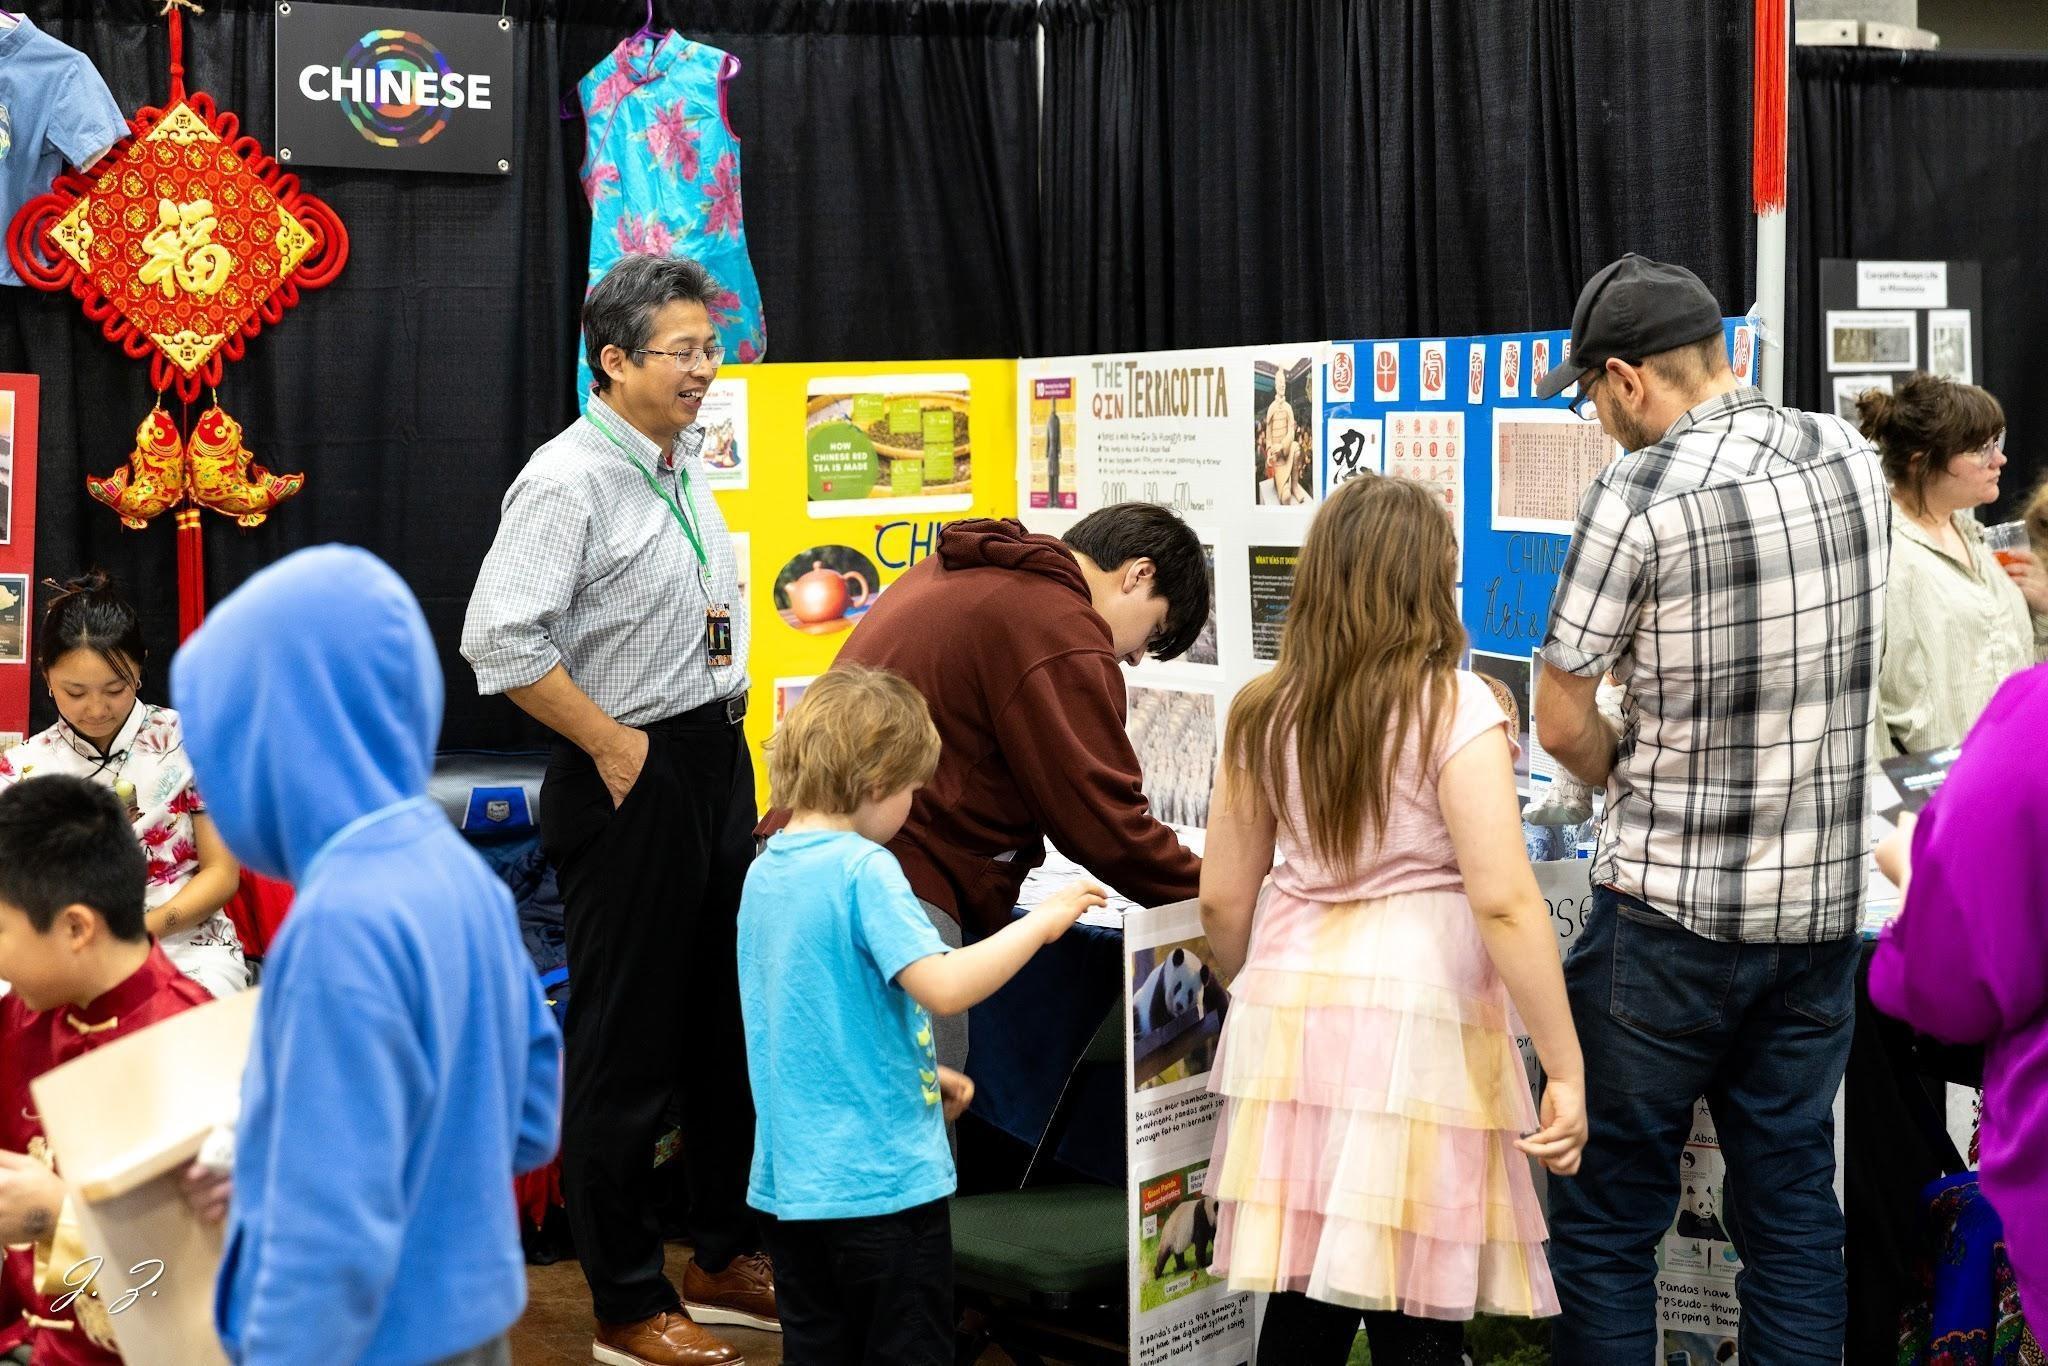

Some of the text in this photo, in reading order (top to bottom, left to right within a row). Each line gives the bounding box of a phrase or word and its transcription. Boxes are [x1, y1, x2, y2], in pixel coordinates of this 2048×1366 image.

[299, 65, 491, 110] CHINESE
[138, 198, 231, 297] 福
[1092, 361, 1228, 418] THE TERRACOTTA
[1093, 392, 1124, 420] QIN
[813, 452, 868, 462] CHINESE RED
[830, 442, 851, 451] HOW
[814, 462, 868, 472] TEA IS MADE
[1508, 535, 1567, 575] CHINE
[1136, 1107, 1163, 1122] Because
[1181, 1093, 1208, 1107] bamboo
[1175, 1107, 1198, 1122] pandas
[1199, 1101, 1213, 1112] don't
[1136, 1131, 1161, 1145] enough
[1162, 1126, 1172, 1136] fat
[1694, 1133, 1718, 1144] Abou
[1144, 1188, 1181, 1211] Characteristics
[1147, 1180, 1177, 1199] Giant Panda
[1166, 1283, 1178, 1294] Large
[1660, 1281, 1731, 1299] Pandas have
[1146, 1326, 1171, 1343] panda's
[1173, 1320, 1187, 1332] diet
[1195, 1311, 1210, 1322] 99%
[1663, 1311, 1739, 1327] gripping bam
[1140, 1344, 1155, 1358] they
[1182, 1322, 1207, 1338] digestive
[1209, 1314, 1229, 1329] system
[1171, 1340, 1193, 1356] leading
[1202, 1327, 1225, 1342] constant
